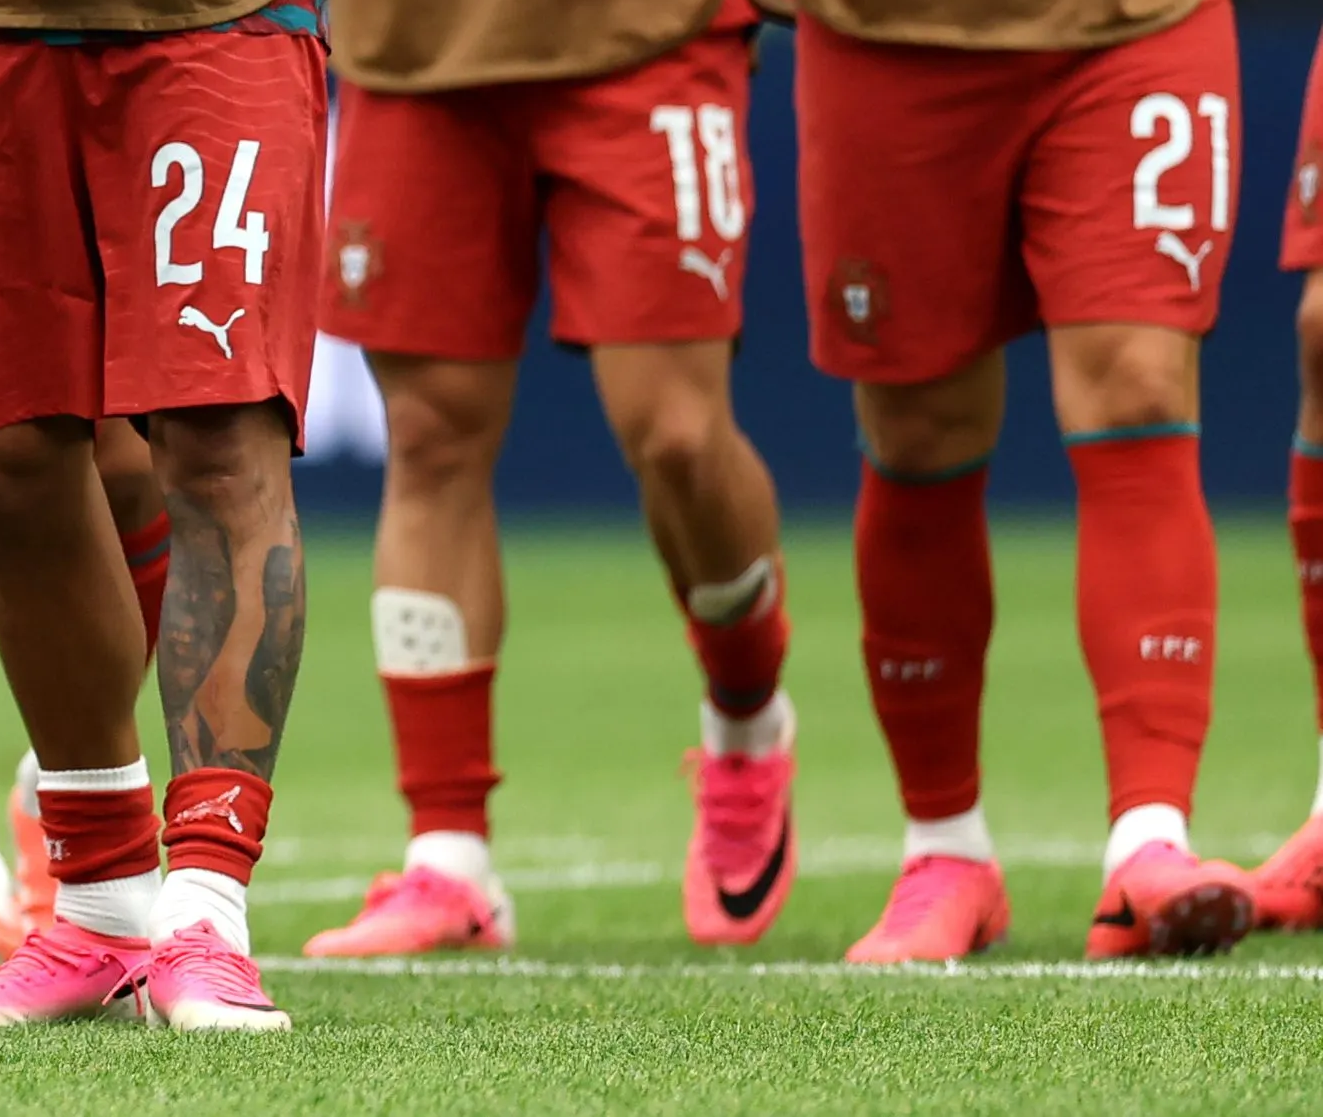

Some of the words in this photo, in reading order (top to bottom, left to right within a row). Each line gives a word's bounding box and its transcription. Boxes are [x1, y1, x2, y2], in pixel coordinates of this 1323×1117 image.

[151, 140, 270, 287] 24
[650, 103, 745, 241] 18
[1130, 92, 1230, 232] 21
